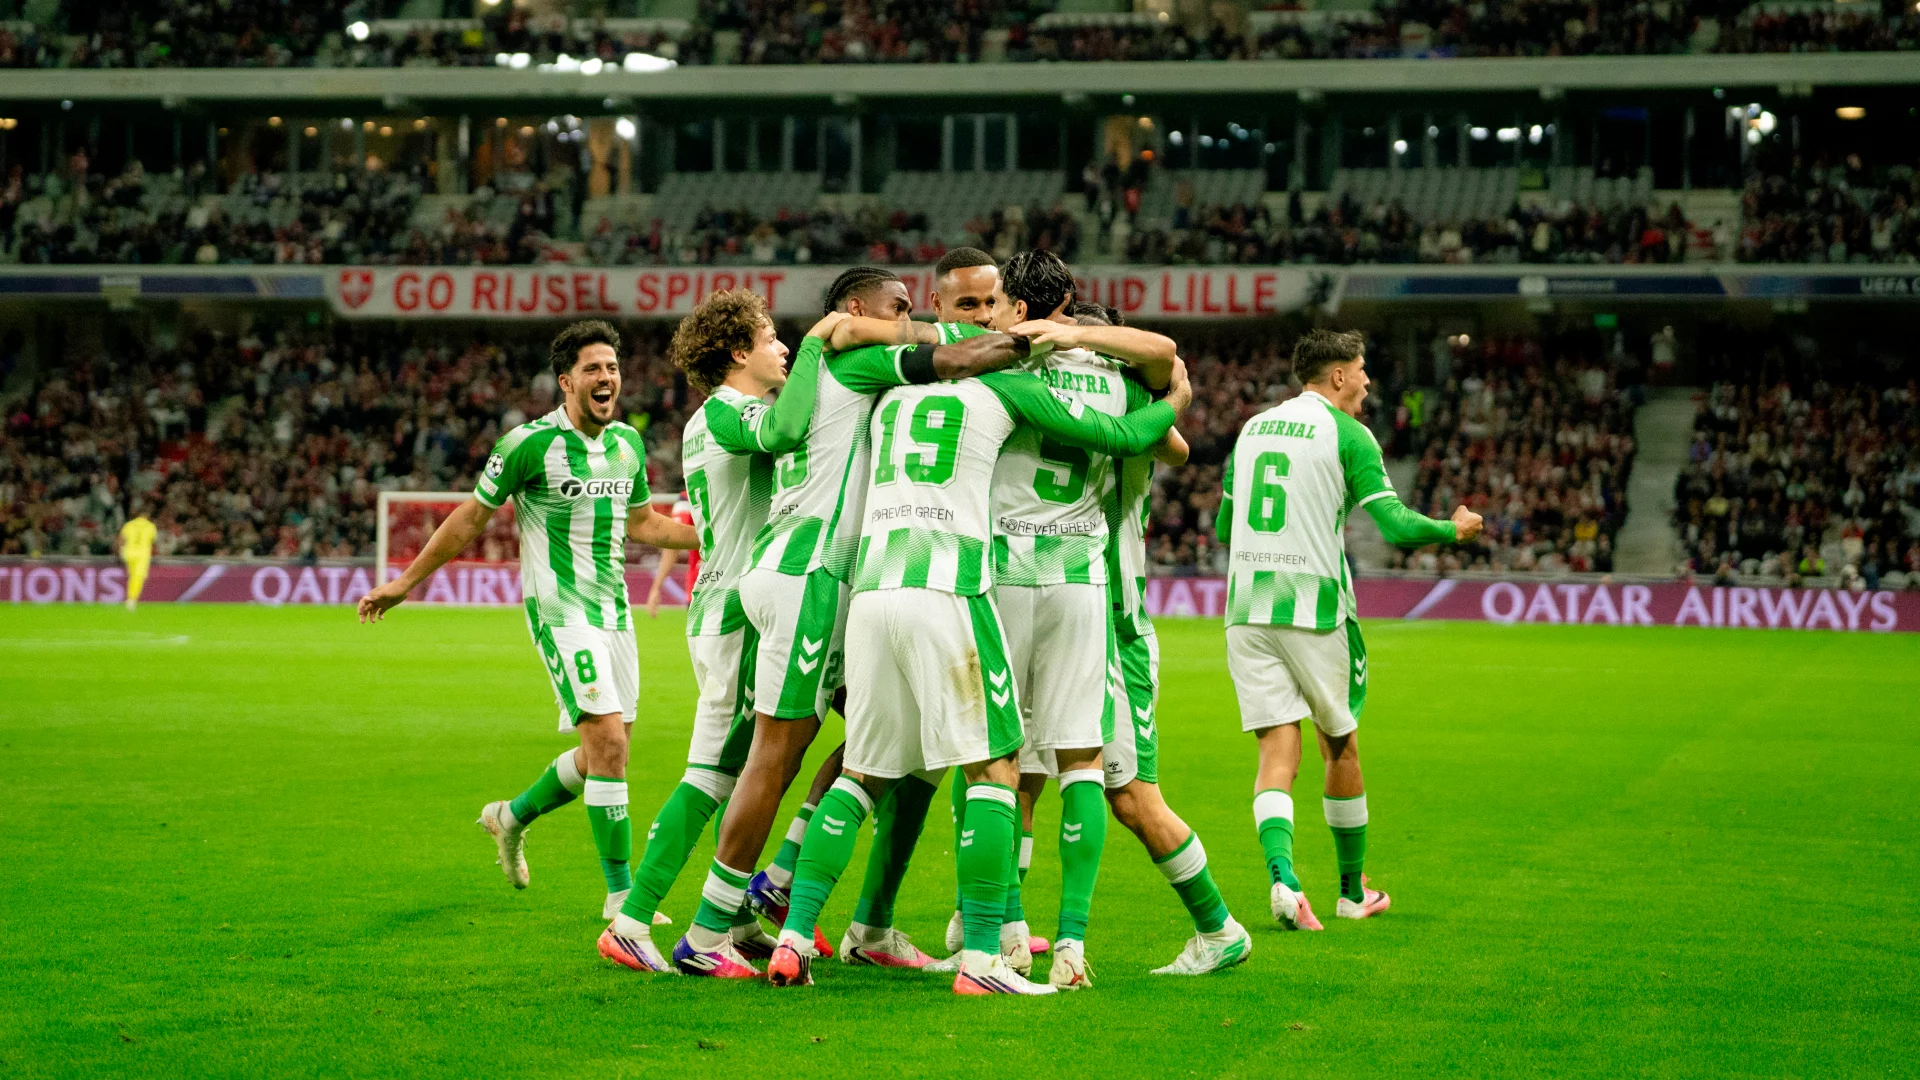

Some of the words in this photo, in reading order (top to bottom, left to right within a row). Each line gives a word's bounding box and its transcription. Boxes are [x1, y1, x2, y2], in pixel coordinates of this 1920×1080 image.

[393, 271, 454, 312] GO
[470, 272, 620, 313] RIJSEL
[1160, 272, 1277, 315] LILLE
[874, 395, 965, 485] 19
[1257, 420, 1317, 440] BERNAL
[586, 480, 632, 496] GREE
[1247, 451, 1291, 533] 6
[915, 506, 954, 521] GREEN
[1059, 520, 1097, 534] GREEN
[1272, 553, 1306, 566] GREEN
[1481, 581, 1654, 627] QATAR
[1675, 586, 1900, 632] AIRWAYS
[574, 649, 597, 684] 8
